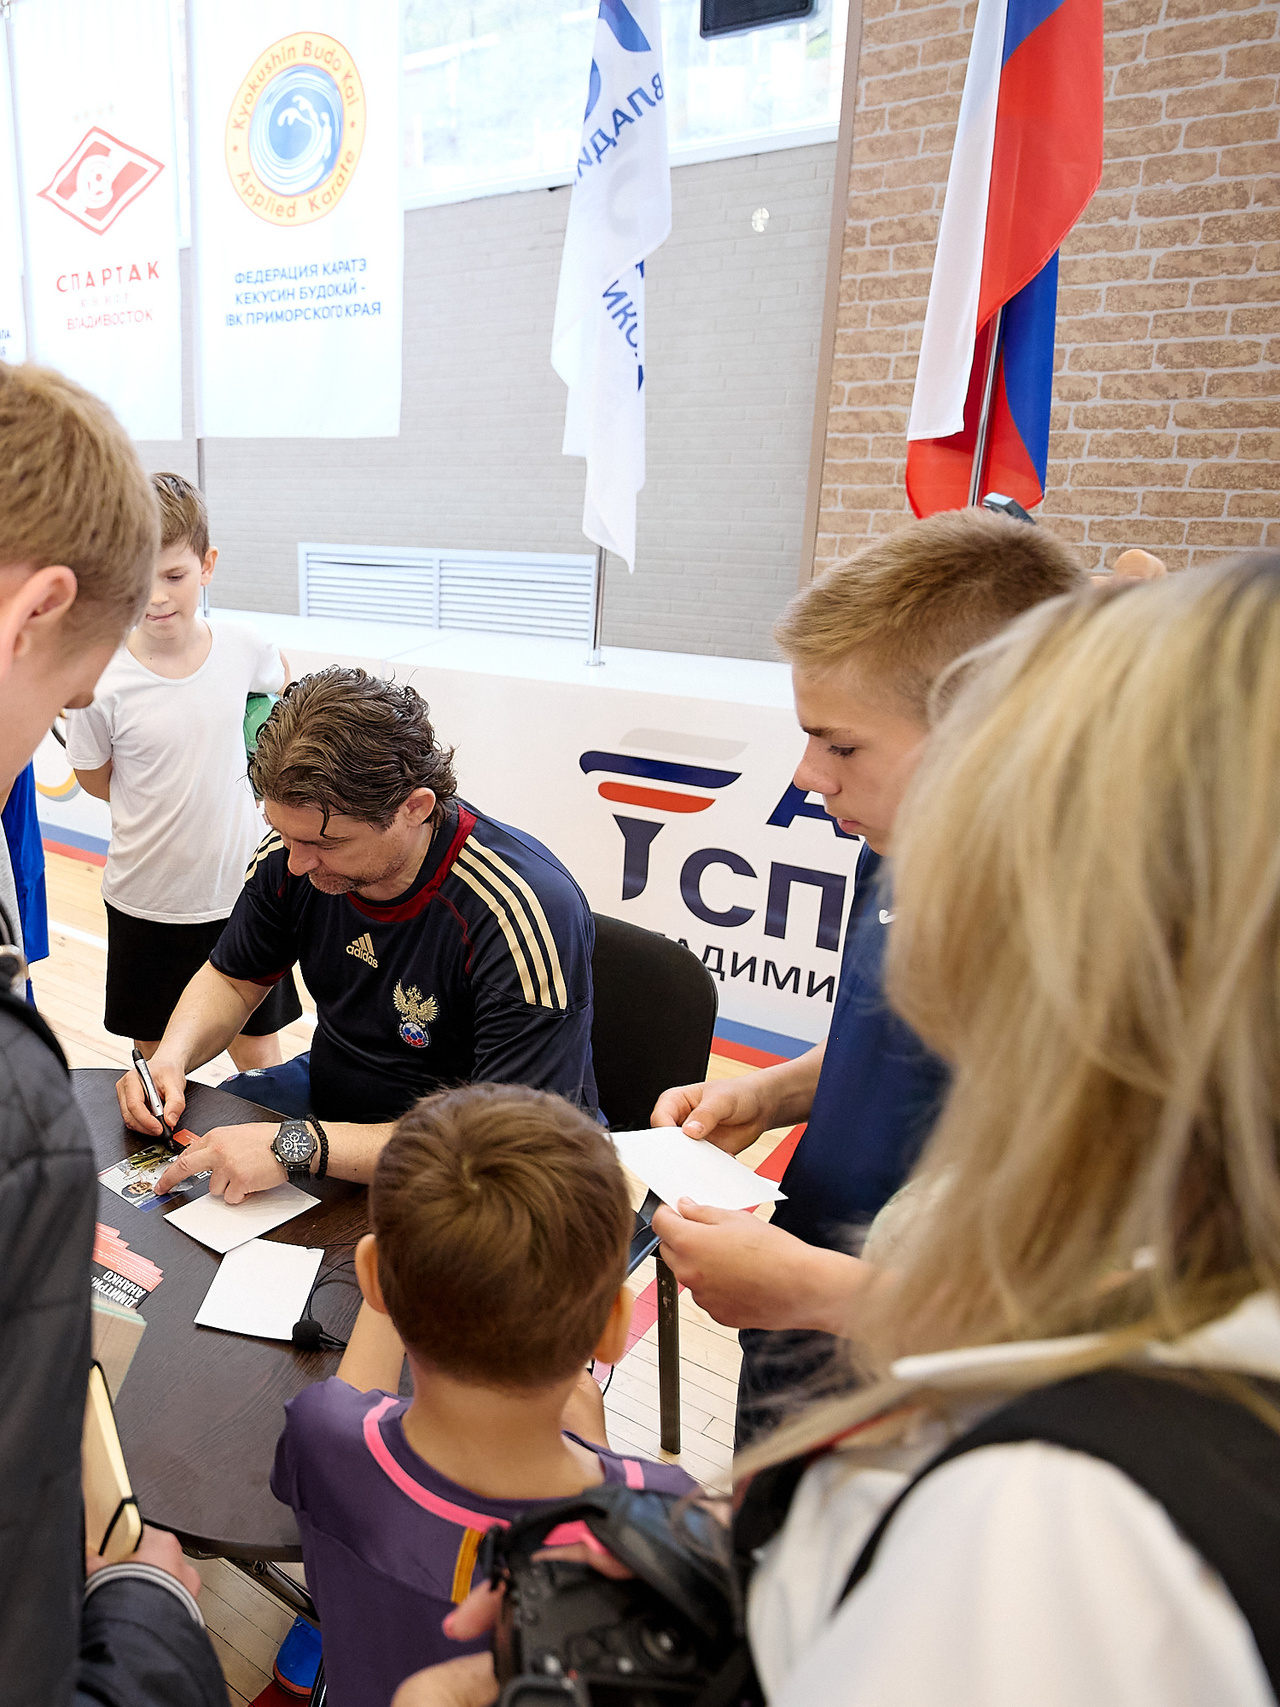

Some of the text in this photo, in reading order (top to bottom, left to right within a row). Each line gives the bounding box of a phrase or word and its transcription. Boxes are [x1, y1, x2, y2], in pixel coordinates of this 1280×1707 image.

[232, 40, 360, 130] Kyokushin Budo Kai
[237, 150, 355, 218] Applied Karate
[56, 261, 160, 293] СПАРТАК
[234, 258, 367, 285] ФЕДЕРАЦИЯ КАРАТЭ
[235, 288, 296, 305] КЕКУСИН
[299, 277, 358, 300] БУДОКАЙ
[67, 309, 153, 331] ВЛАДИВОСТОК
[246, 305, 343, 325] ПРИМОРСКОГО
[345, 302, 382, 317] КРАЯ
[345, 944, 379, 969] adidas
[651, 931, 836, 1003] ДИМИ
[91, 1274, 139, 1309] ДМИТРИ
[102, 1270, 147, 1299] АНАНКО
